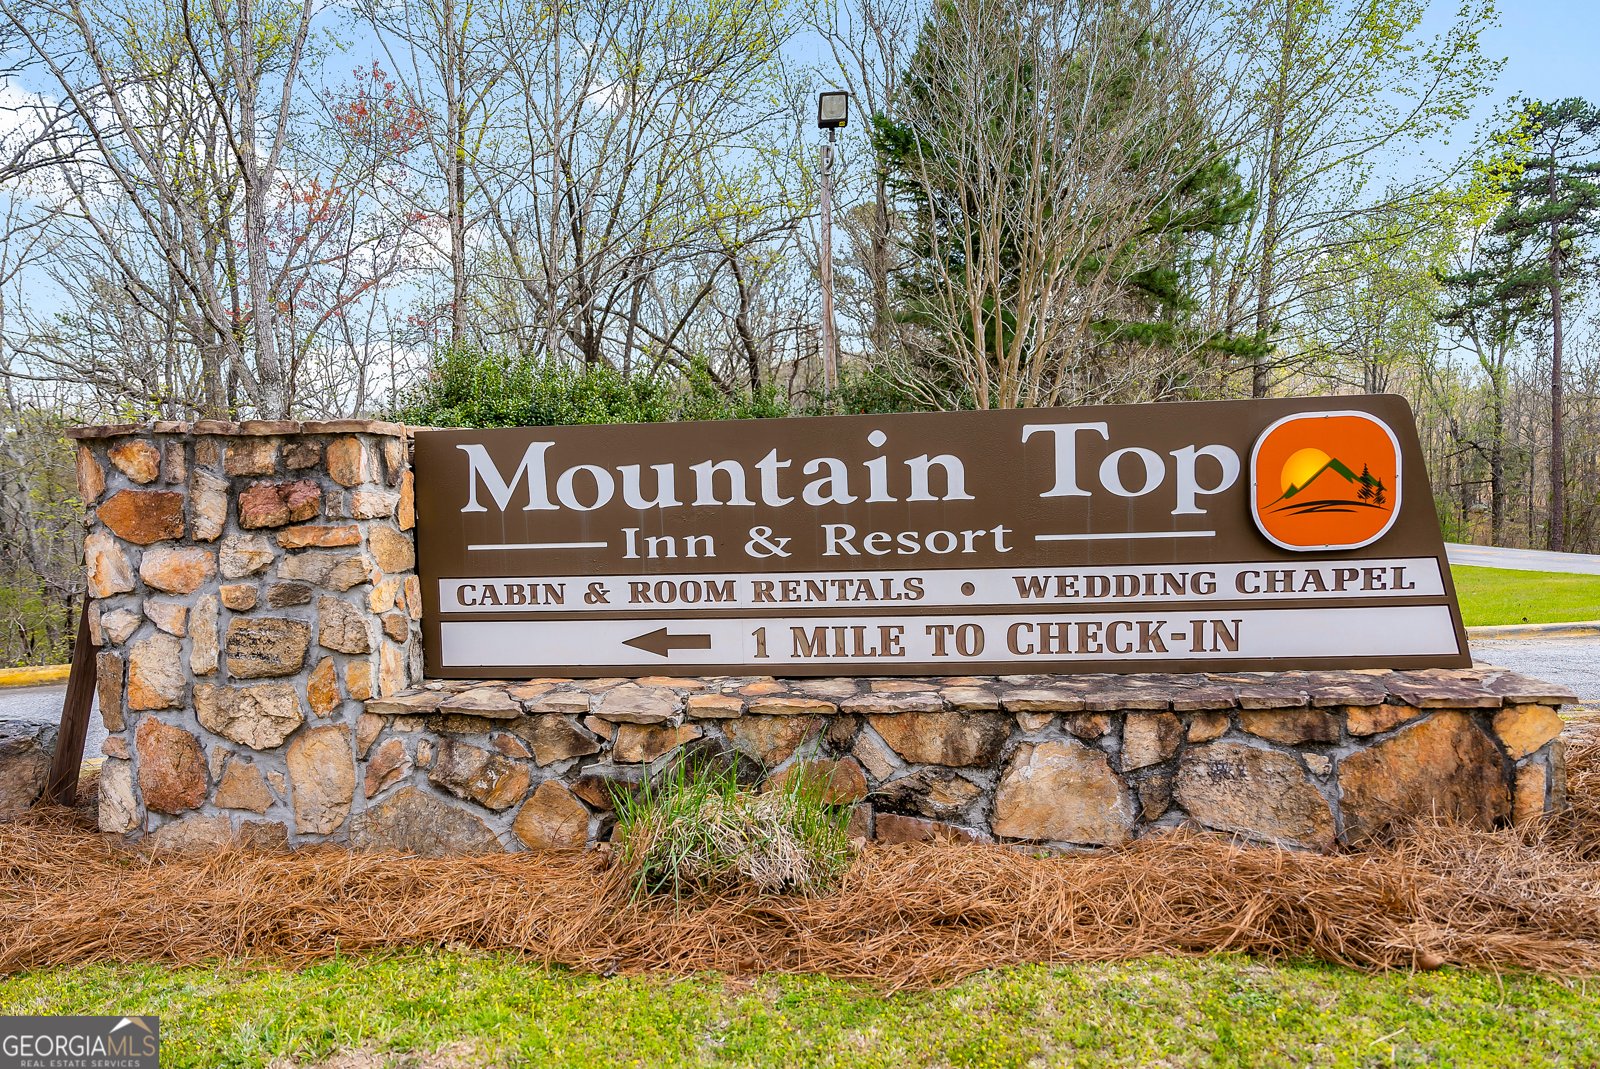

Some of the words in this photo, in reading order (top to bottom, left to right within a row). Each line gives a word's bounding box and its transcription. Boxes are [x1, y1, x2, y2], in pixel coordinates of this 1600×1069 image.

[455, 429, 976, 514] Mountain
[1021, 420, 1241, 516] Top
[621, 526, 716, 560] Inn
[744, 525, 792, 558] &
[821, 523, 1014, 557] Resort
[455, 582, 567, 607] CABIN
[583, 581, 611, 605] &
[628, 579, 738, 604] ROOM
[751, 576, 925, 603] RENTALS
[1012, 570, 1218, 599] WEDDING
[1234, 565, 1416, 594] CHAPEL
[751, 626, 768, 660] 1
[789, 624, 907, 659] MILE
[925, 623, 986, 658] TO
[1005, 618, 1243, 656] CHECK-IN
